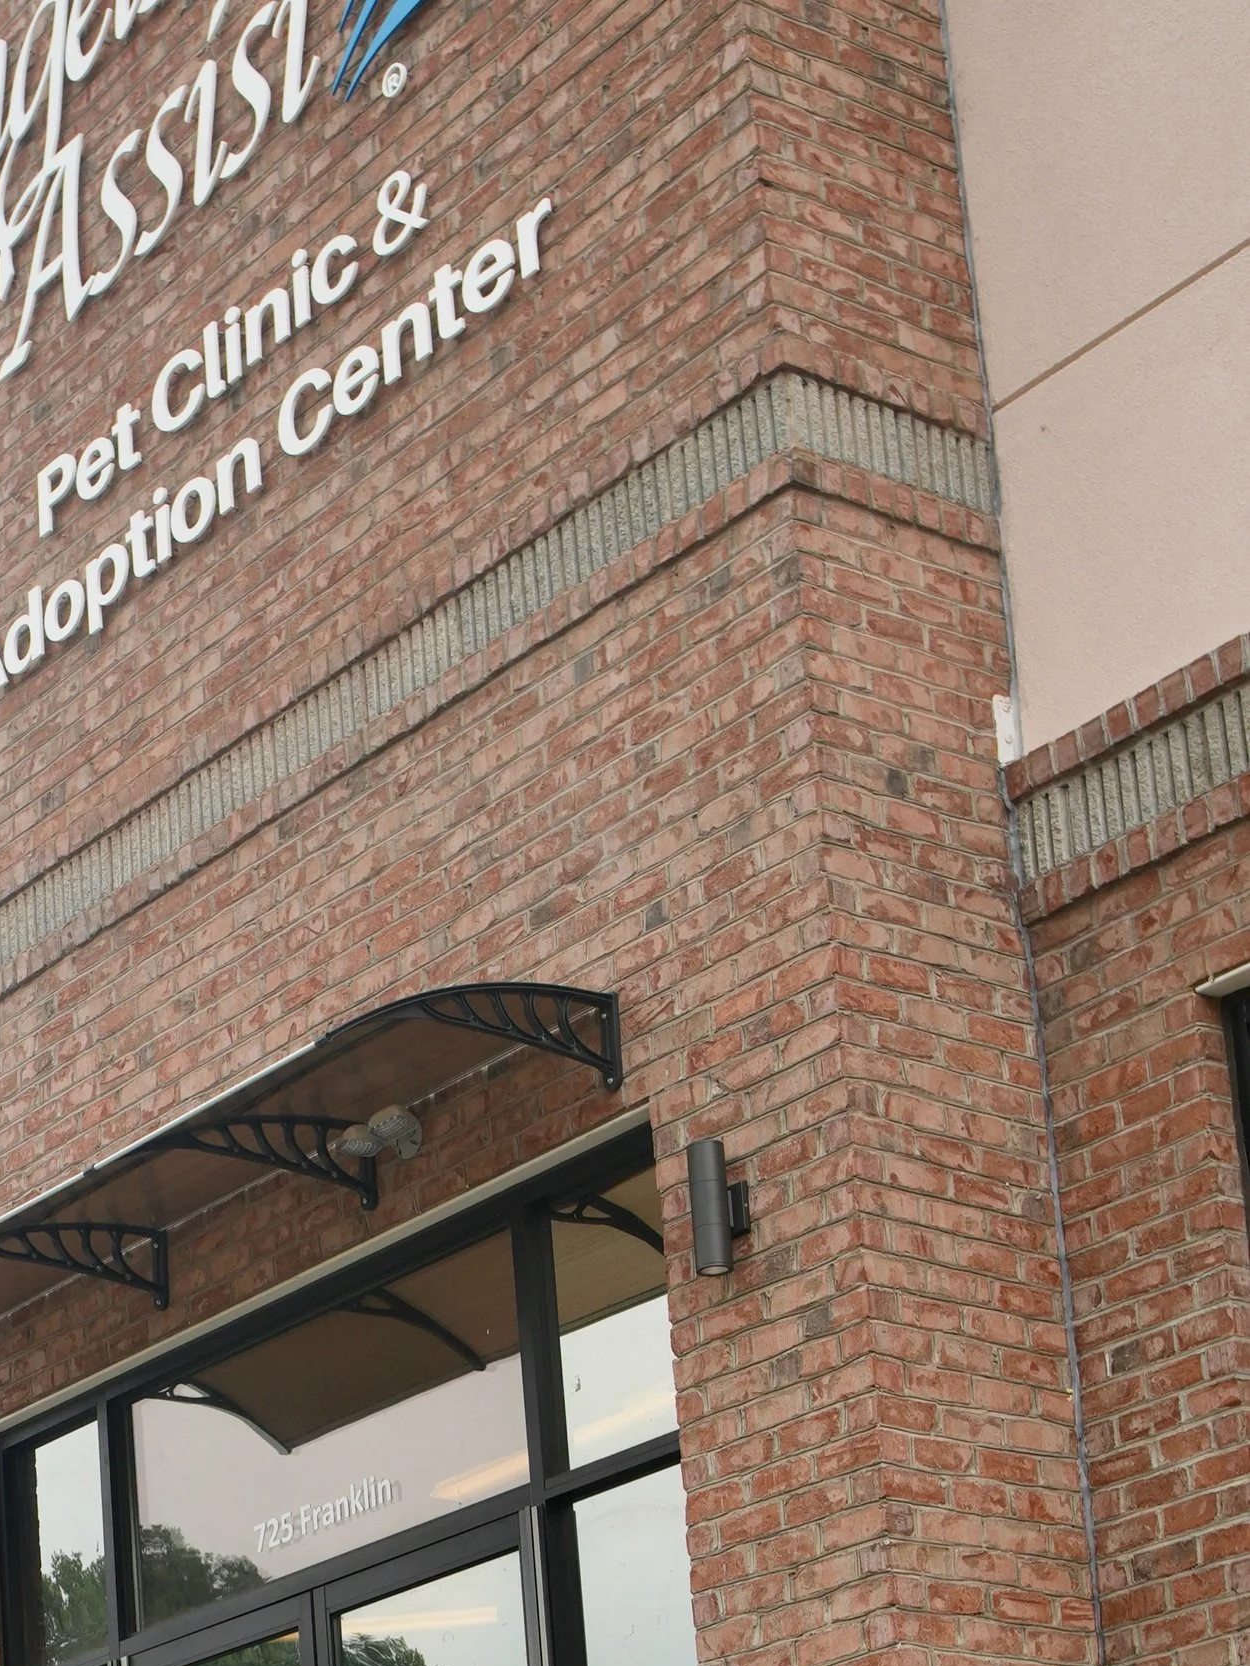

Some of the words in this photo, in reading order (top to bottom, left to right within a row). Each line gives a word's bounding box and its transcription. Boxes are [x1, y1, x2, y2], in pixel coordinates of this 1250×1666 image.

[37, 402, 141, 537] Pet
[151, 234, 359, 433] Clinic
[373, 170, 429, 256] &
[278, 197, 551, 455] Center
[254, 1512, 293, 1553] 725
[300, 1476, 392, 1535] Franklin
